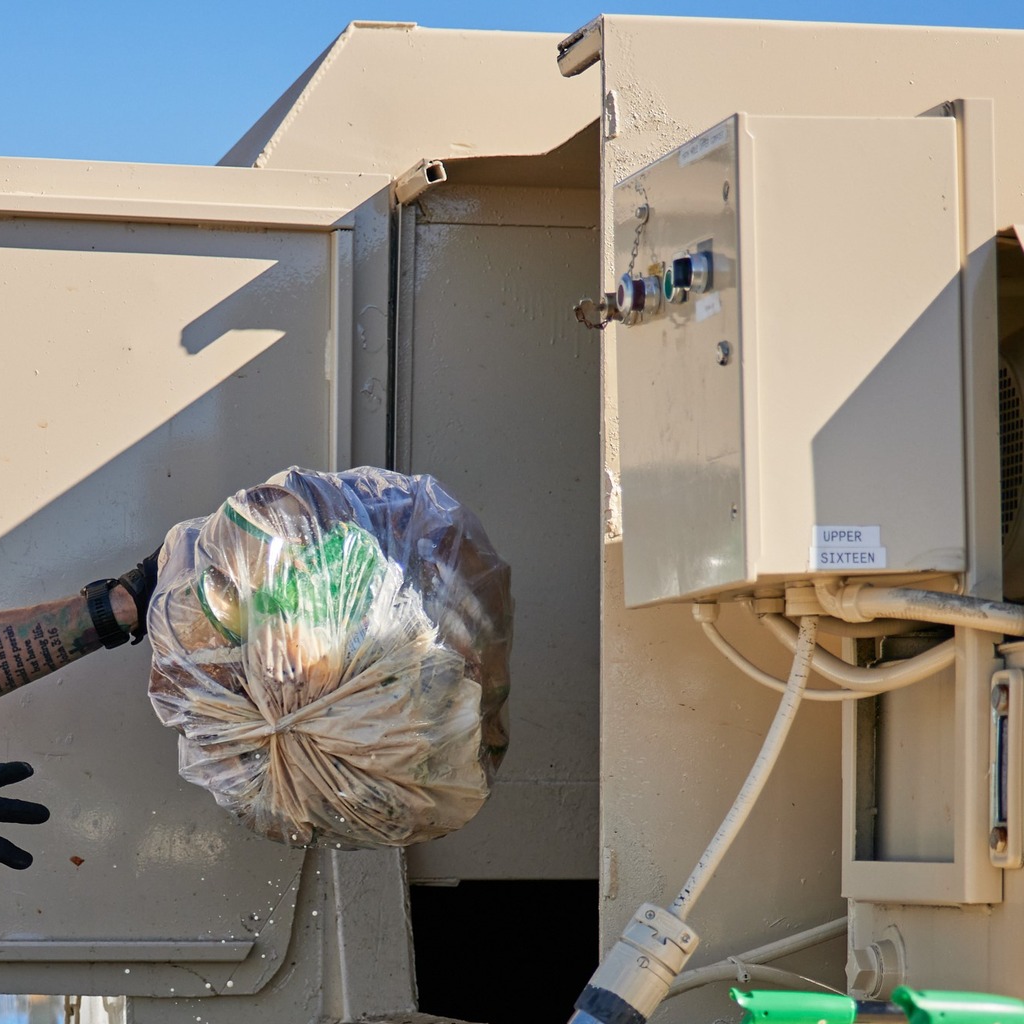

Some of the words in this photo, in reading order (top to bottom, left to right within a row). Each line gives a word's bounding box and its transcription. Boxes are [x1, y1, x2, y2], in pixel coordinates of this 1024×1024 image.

[823, 530, 862, 542] UPPER
[820, 552, 875, 564] SIXTEEN
[24, 639, 36, 661] have
[12, 653, 24, 668] not
[29, 660, 41, 674] but
